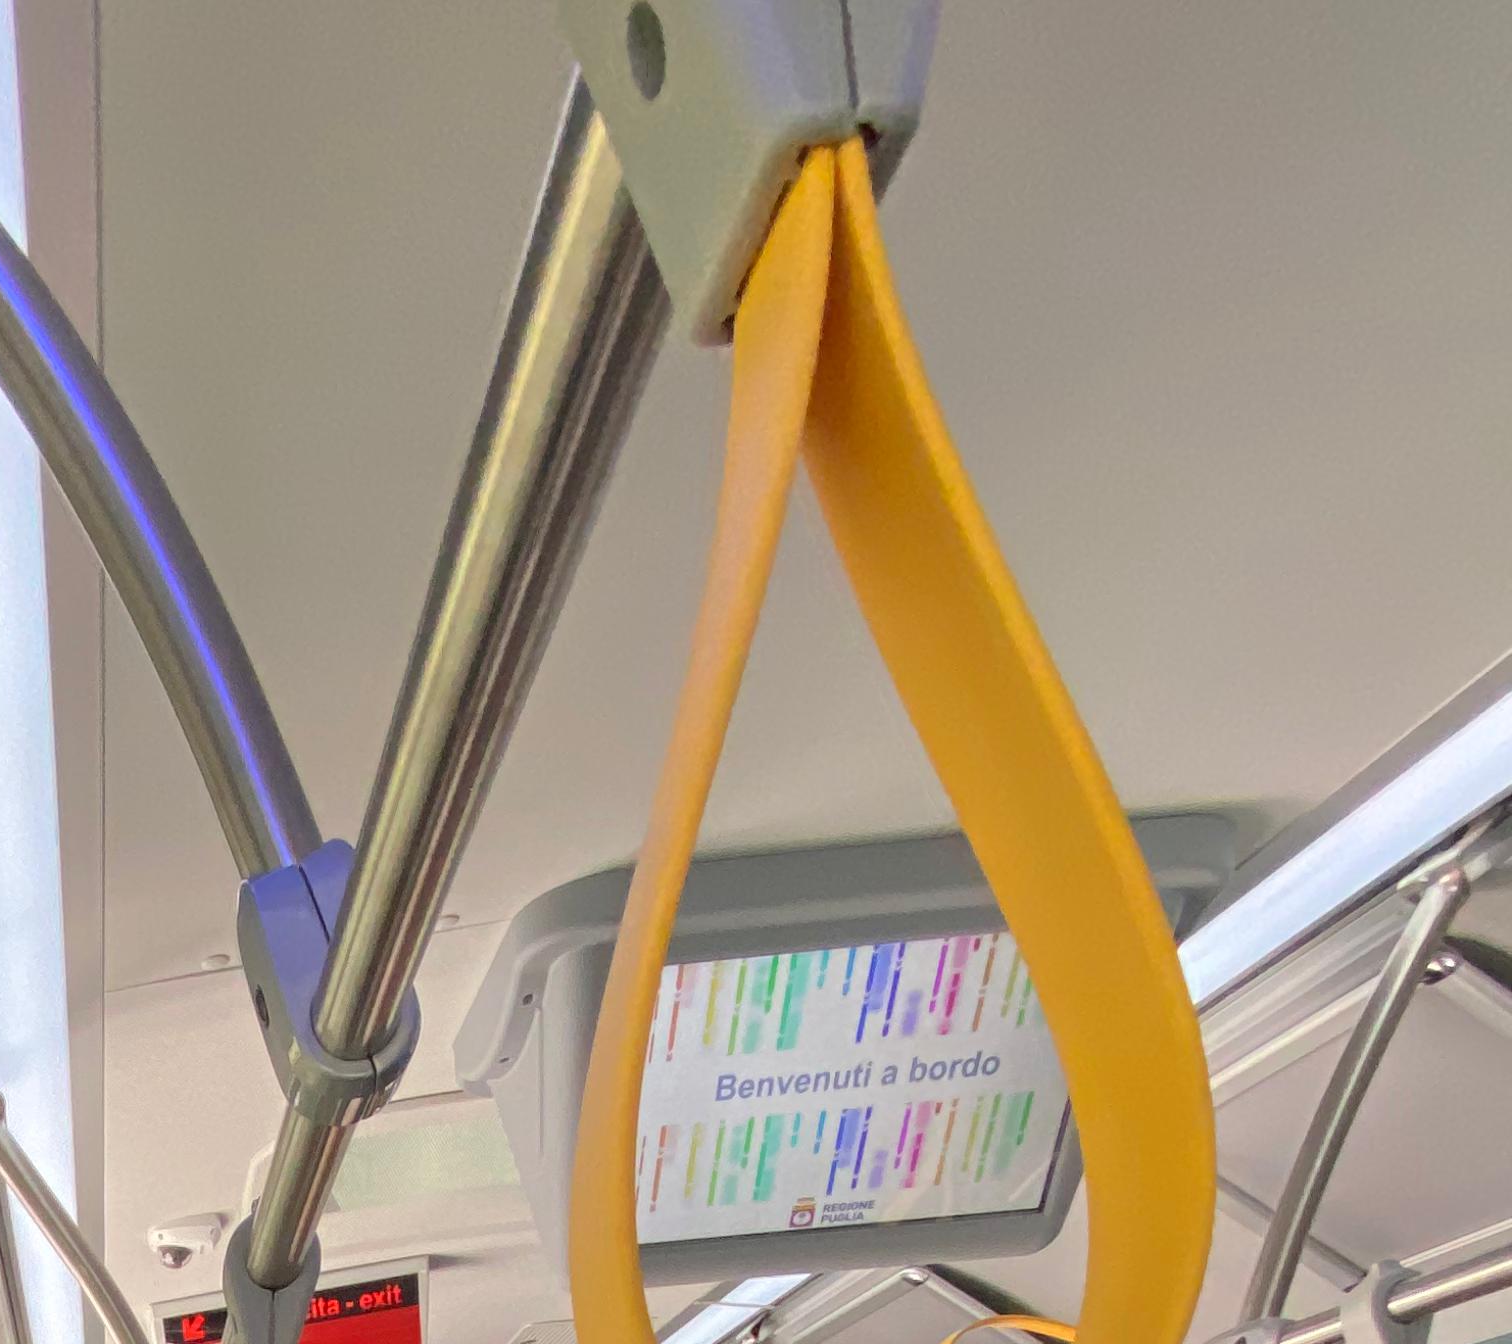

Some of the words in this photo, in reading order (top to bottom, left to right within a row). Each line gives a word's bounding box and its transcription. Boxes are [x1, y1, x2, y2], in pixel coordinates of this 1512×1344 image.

[715, 1061, 873, 1101] Benvenuti
[881, 1064, 898, 1085] a
[909, 1050, 1001, 1083] bordo
[823, 1200, 875, 1212] REGIONE
[821, 1211, 864, 1224] PUGLIA
[359, 1284, 402, 1310] exit
